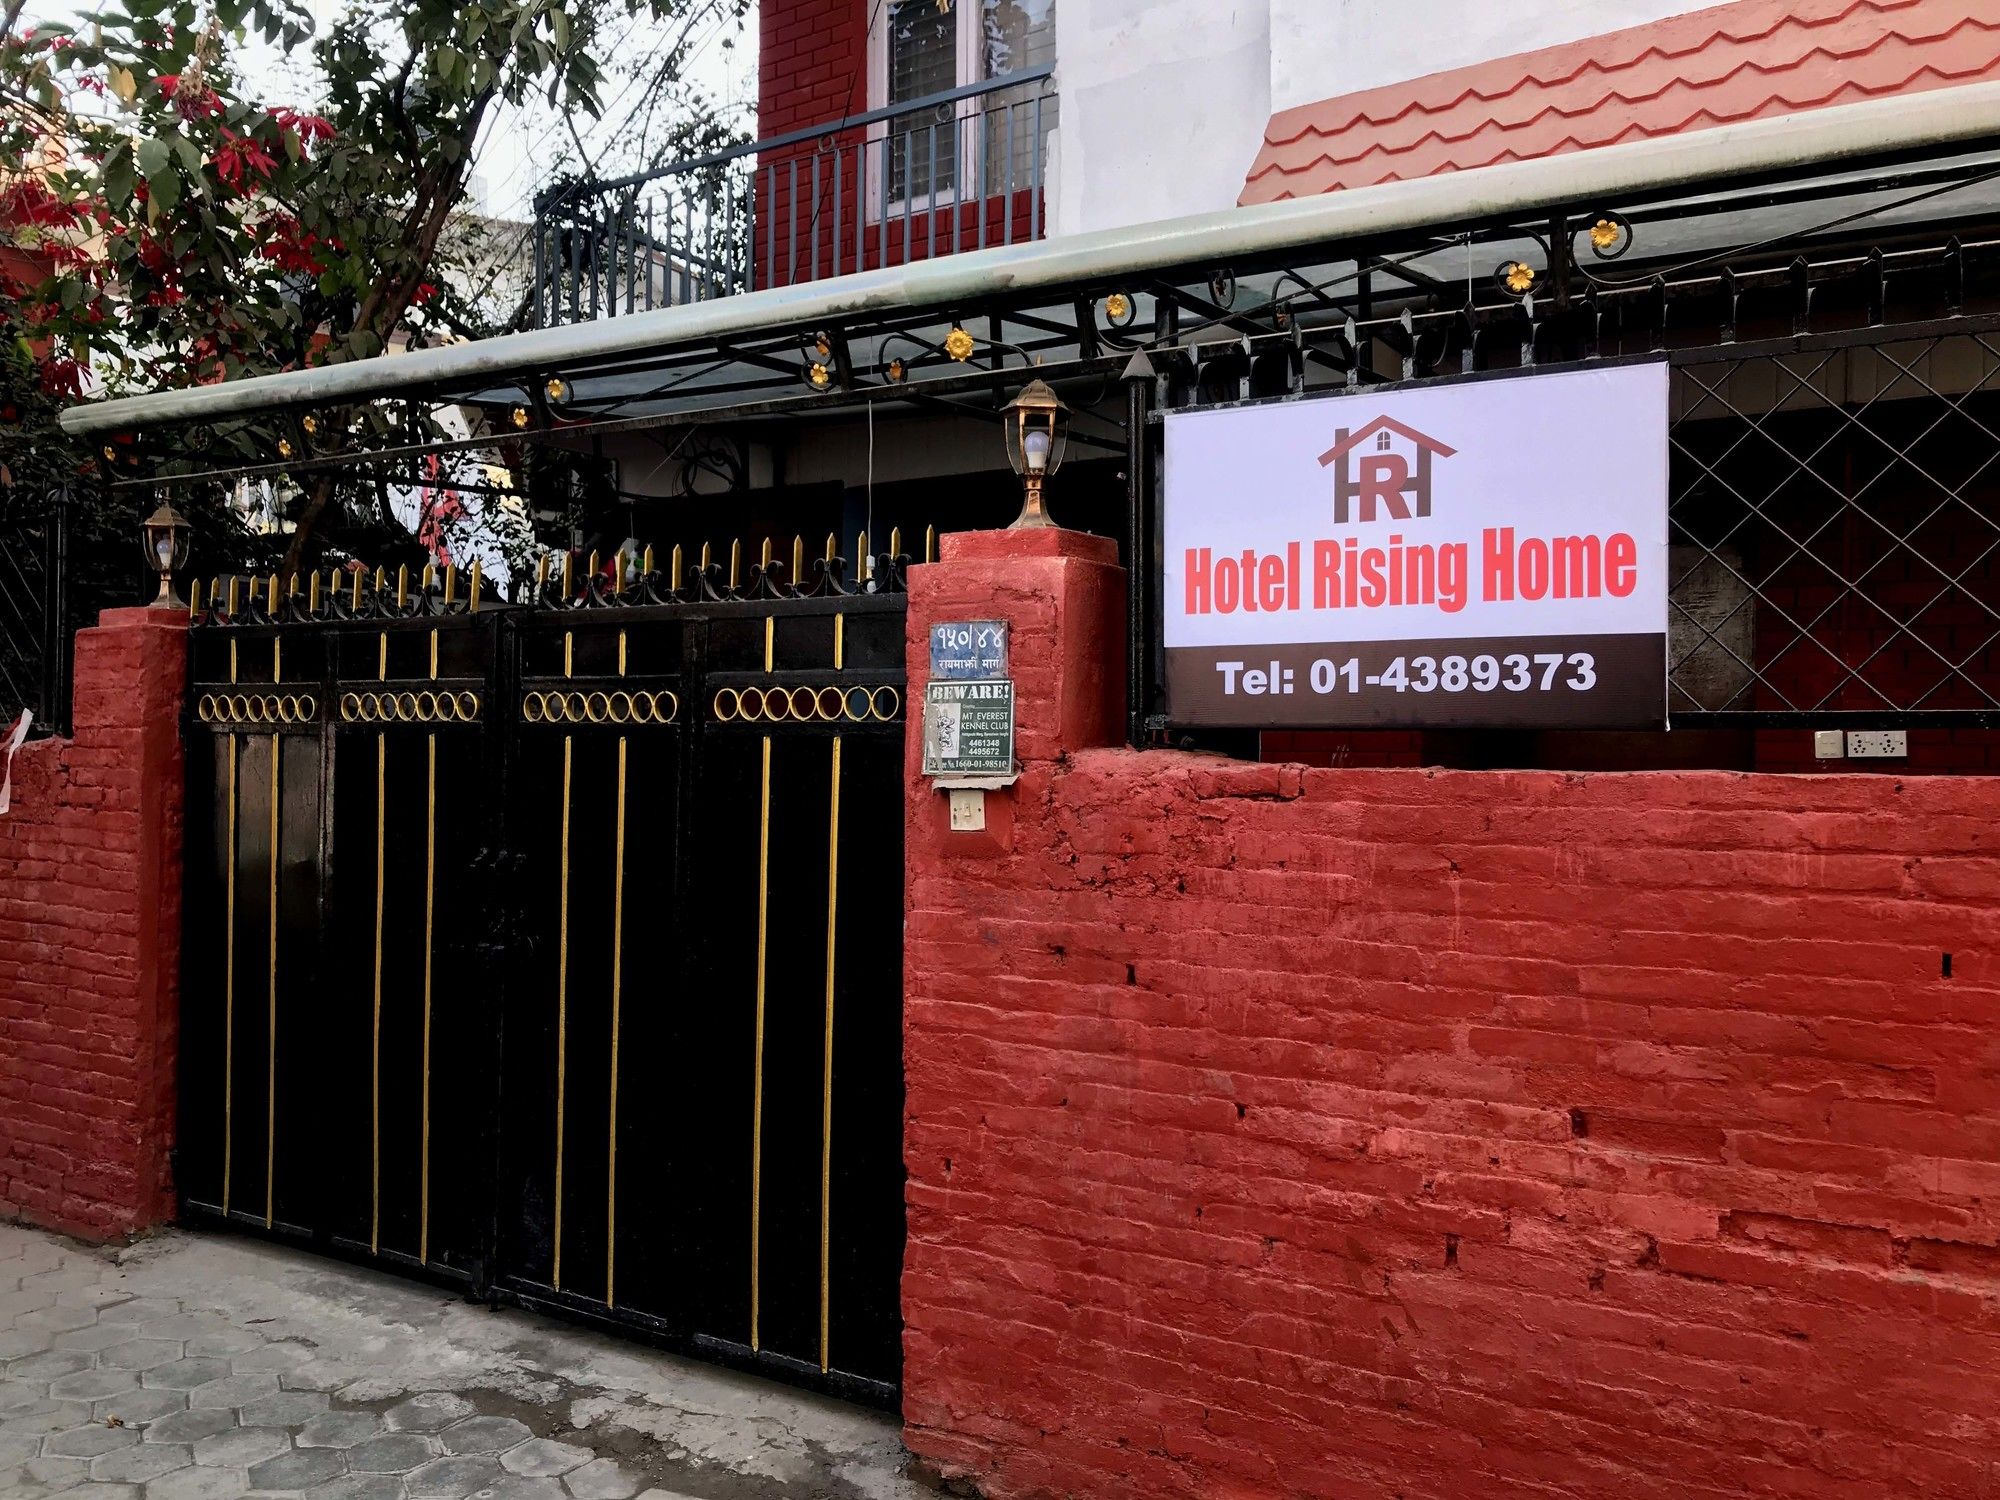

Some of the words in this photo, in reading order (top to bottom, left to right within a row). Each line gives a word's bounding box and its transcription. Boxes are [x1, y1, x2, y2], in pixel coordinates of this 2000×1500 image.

[1184, 541, 1300, 615] Hotel
[1313, 534, 1468, 614] Rising
[1482, 527, 1637, 602] Home
[1216, 661, 1294, 695] Tel:
[1310, 652, 1597, 695] 01-4389373
[932, 684, 1010, 700] BEWARE!
[961, 712, 973, 720] MT
[976, 711, 1009, 720] EVEREST
[961, 722, 989, 730] KENNEL
[990, 721, 1009, 730] CLUB
[968, 739, 1000, 747] 4461348
[968, 747, 1000, 756] 4495672
